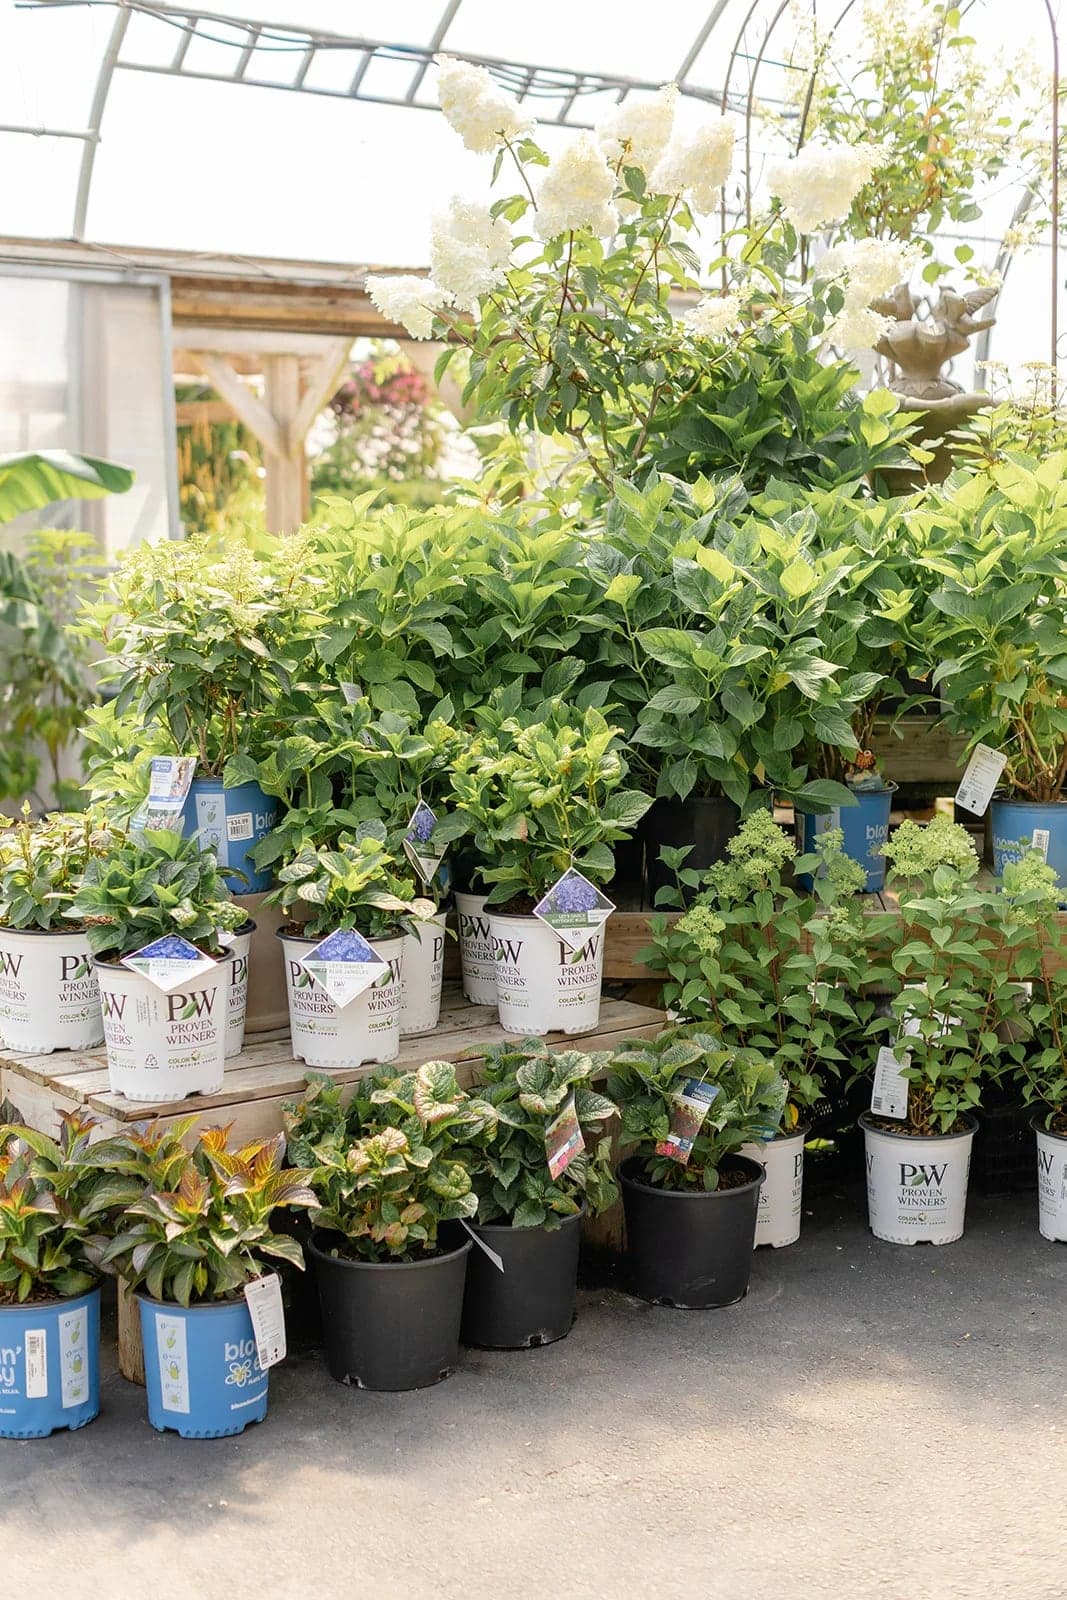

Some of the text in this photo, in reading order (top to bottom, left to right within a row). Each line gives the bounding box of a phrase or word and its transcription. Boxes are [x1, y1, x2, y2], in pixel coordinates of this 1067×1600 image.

[460, 913, 491, 939] PW
[0, 951, 24, 979] W
[497, 964, 521, 976] OVEN
[562, 963, 598, 977] PROVEN
[497, 975, 526, 987] NNERS
[557, 971, 600, 987] WINNERS
[58, 989, 100, 1002] WINNER
[293, 989, 329, 1004] PROVEN
[372, 985, 401, 1001] PROVE
[102, 991, 128, 1021] W
[165, 986, 218, 1022] PW
[367, 997, 401, 1012] WINNE
[171, 1018, 214, 1034] PROVEN
[368, 1022, 387, 1030] COLOR
[166, 1028, 217, 1045] WINNERS
[168, 1055, 191, 1065] COLOR
[898, 1162, 949, 1187] PW
[902, 1188, 943, 1198] PROVEN
[897, 1196, 947, 1207] WINNERS
[224, 1339, 256, 1362] blo
